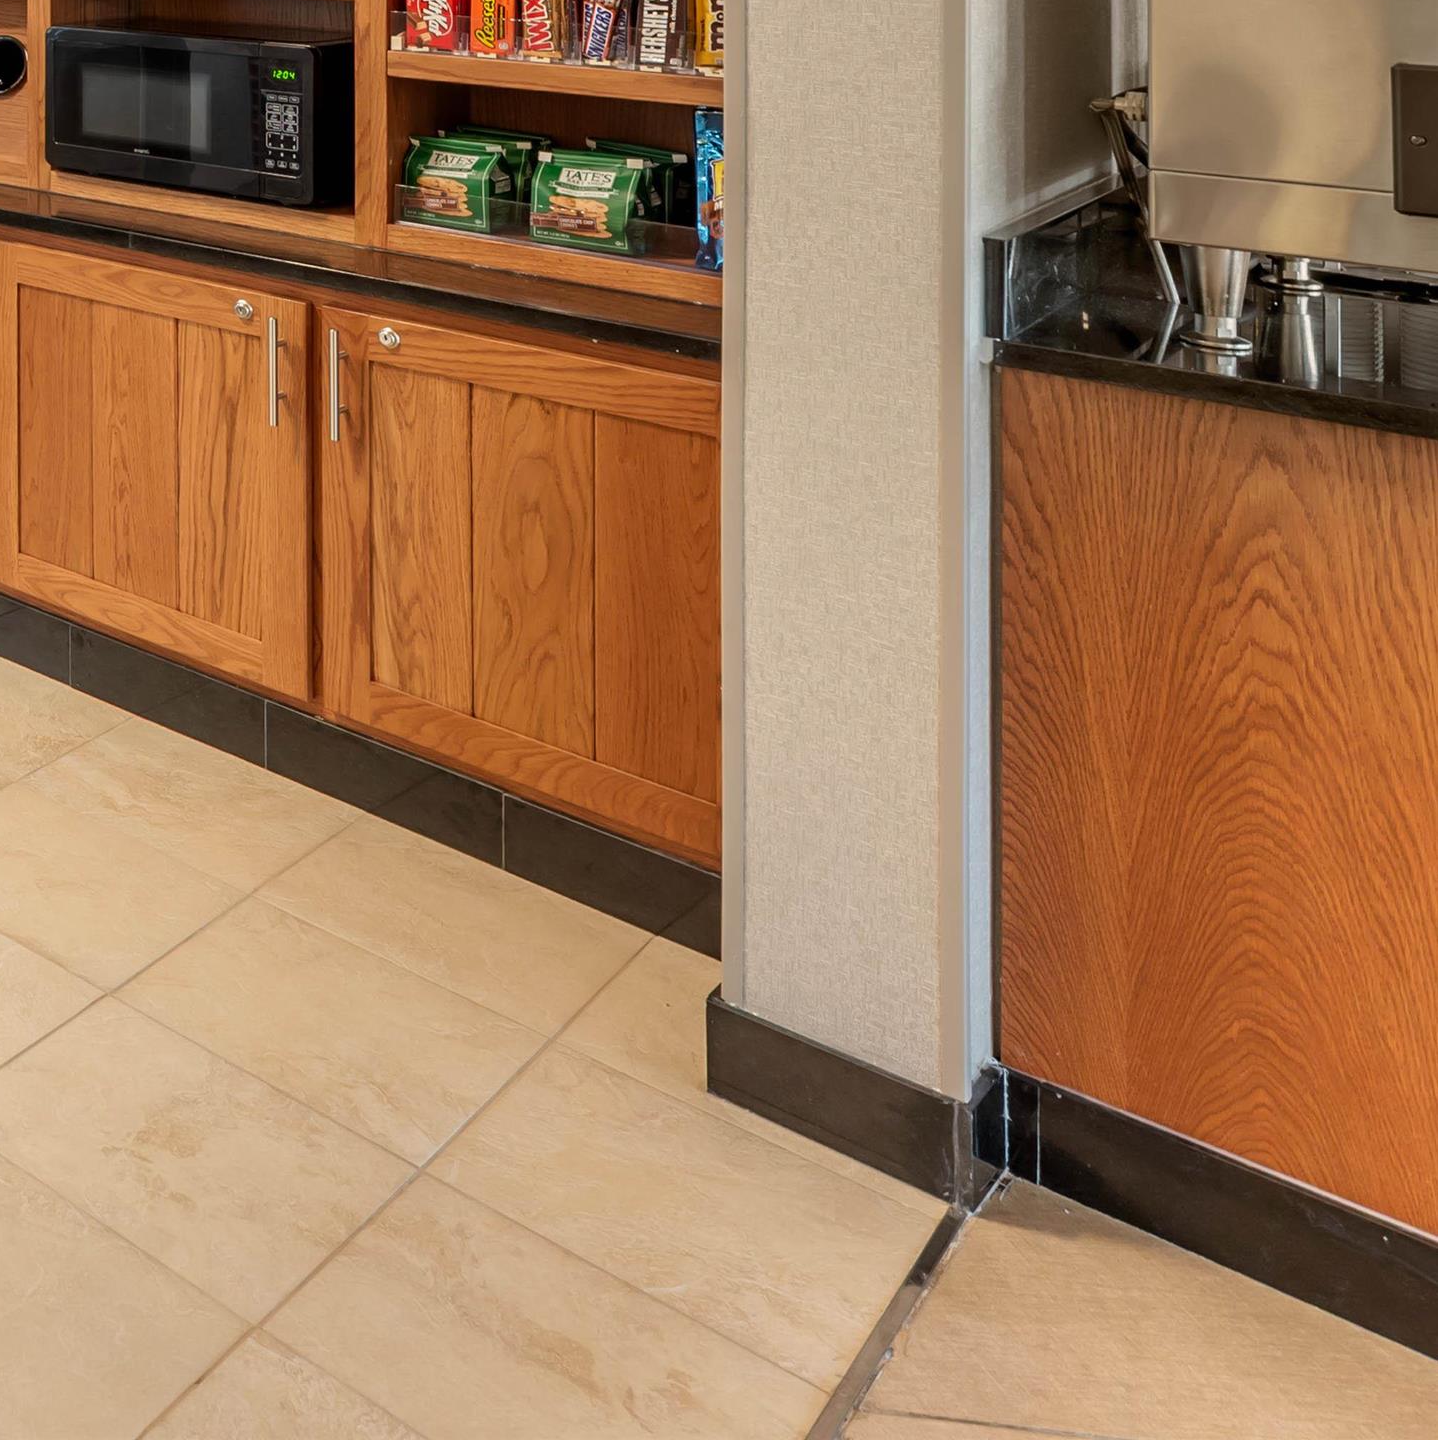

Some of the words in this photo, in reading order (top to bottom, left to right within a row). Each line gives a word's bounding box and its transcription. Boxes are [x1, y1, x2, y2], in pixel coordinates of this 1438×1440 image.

[587, 6, 613, 61] SNICKERS
[435, 153, 475, 165] TATE'S
[566, 170, 612, 183] TATE'S
